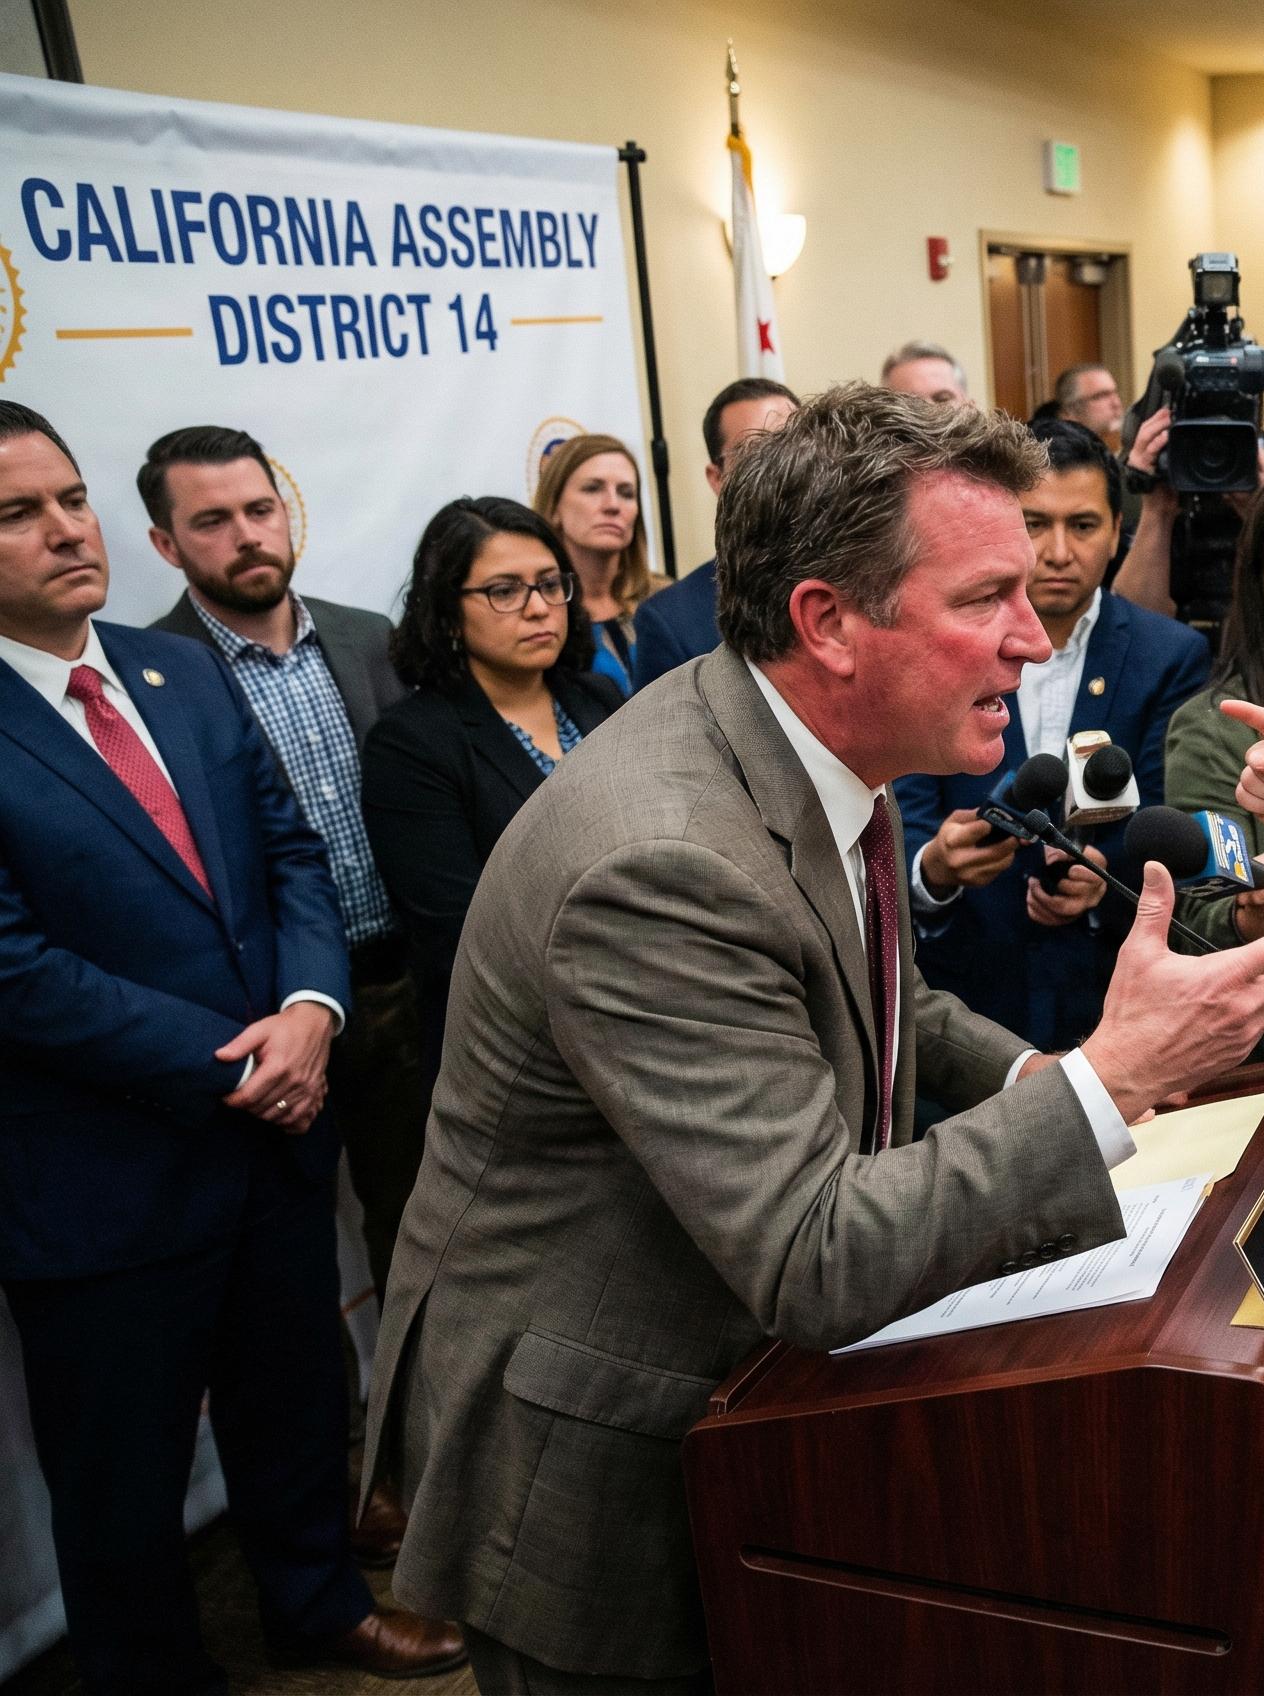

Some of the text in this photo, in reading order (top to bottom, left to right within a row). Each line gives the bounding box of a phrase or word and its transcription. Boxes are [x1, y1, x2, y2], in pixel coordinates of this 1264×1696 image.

[20, 177, 599, 269] CALIFORNIA ASSEMBLY
[208, 293, 498, 366] DISTRICT 14
